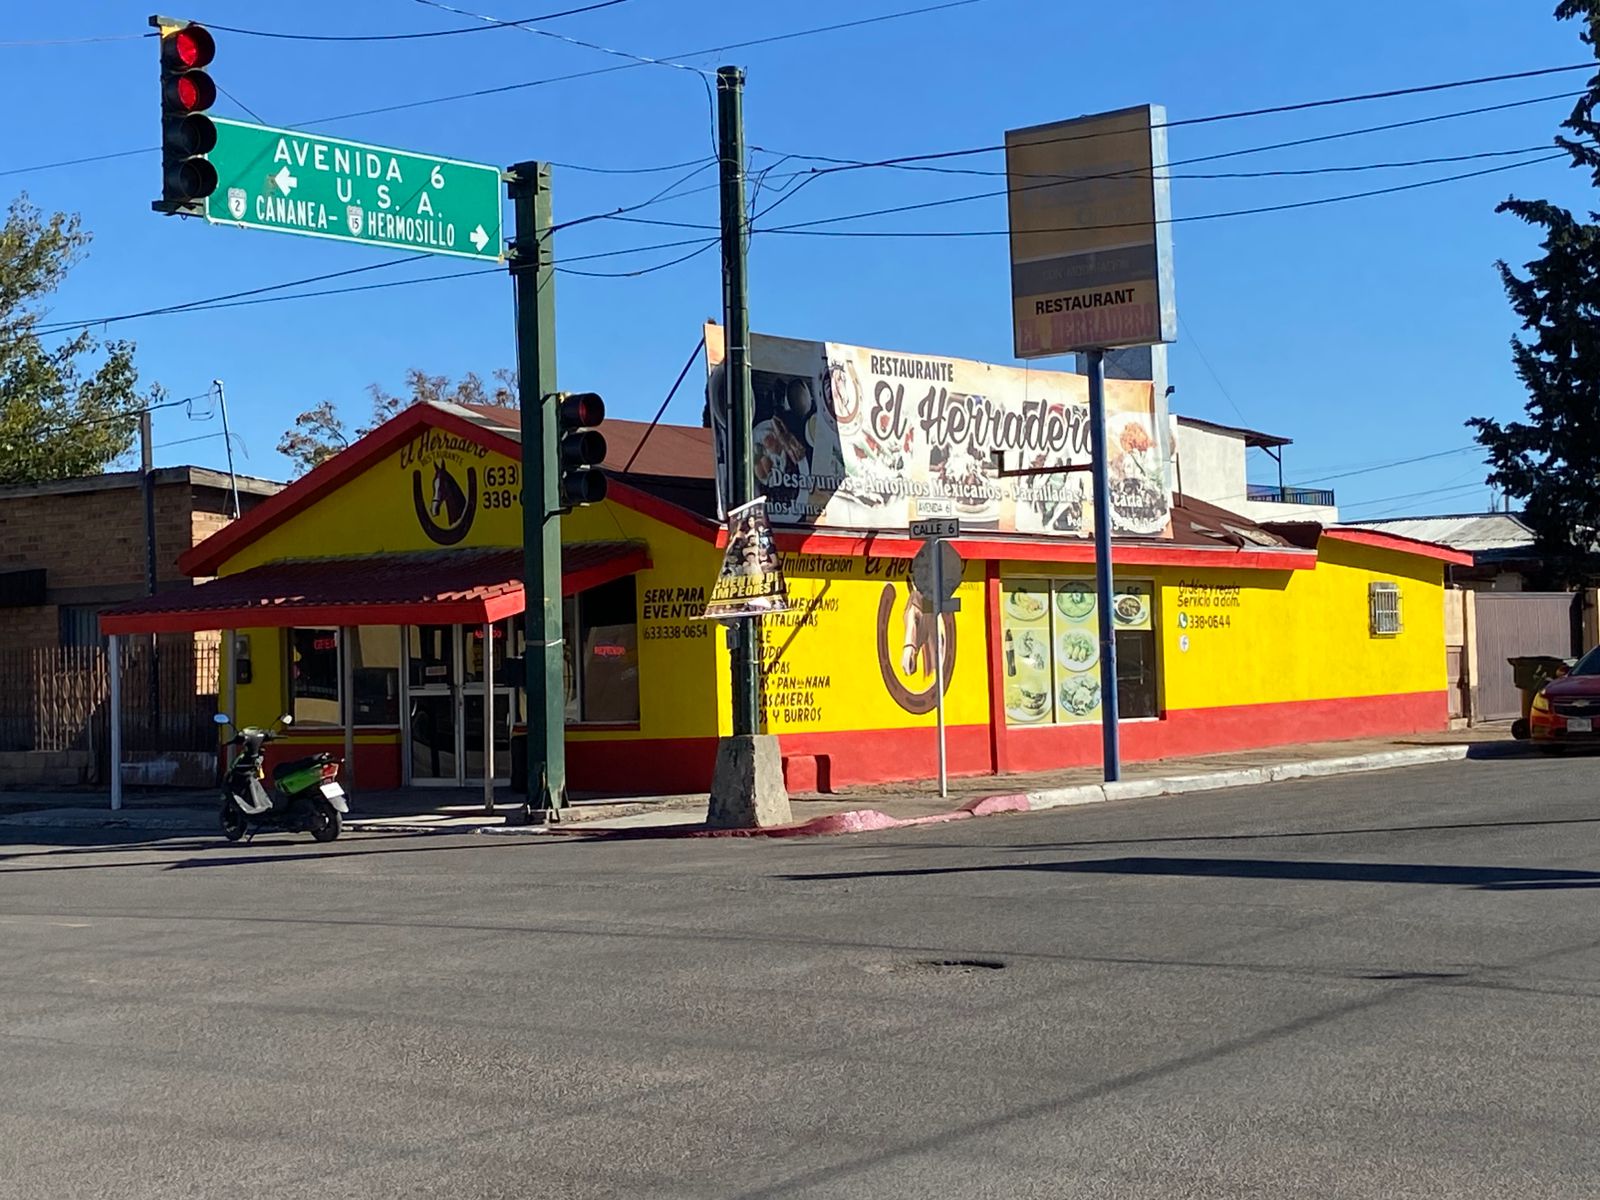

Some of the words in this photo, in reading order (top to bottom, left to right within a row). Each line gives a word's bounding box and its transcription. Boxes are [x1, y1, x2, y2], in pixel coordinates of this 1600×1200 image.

[273, 138, 402, 184] AVENIDA
[431, 165, 445, 189] 6
[234, 199, 241, 212] 2
[351, 217, 360, 230] 15
[368, 211, 455, 248] HERMOSILLO
[1035, 288, 1135, 315] RESTAURANT
[871, 354, 954, 382] RESTAURANTE
[870, 380, 907, 441] El
[484, 463, 519, 488] (633)
[771, 467, 853, 495] Desayunos
[864, 474, 930, 499] Antojitos
[931, 478, 1002, 500] Mexicanos
[912, 523, 942, 536] CALLE
[948, 523, 955, 534] 6
[643, 588, 674, 604] SERV.
[677, 586, 705, 602] PARA
[712, 583, 771, 599] AMPEONES
[643, 603, 706, 619] EVENTOS
[777, 676, 796, 690] PAN
[804, 675, 831, 689] NANA
[774, 691, 815, 707] CASERAS
[773, 709, 780, 722] Y
[784, 707, 822, 723] BURROS
